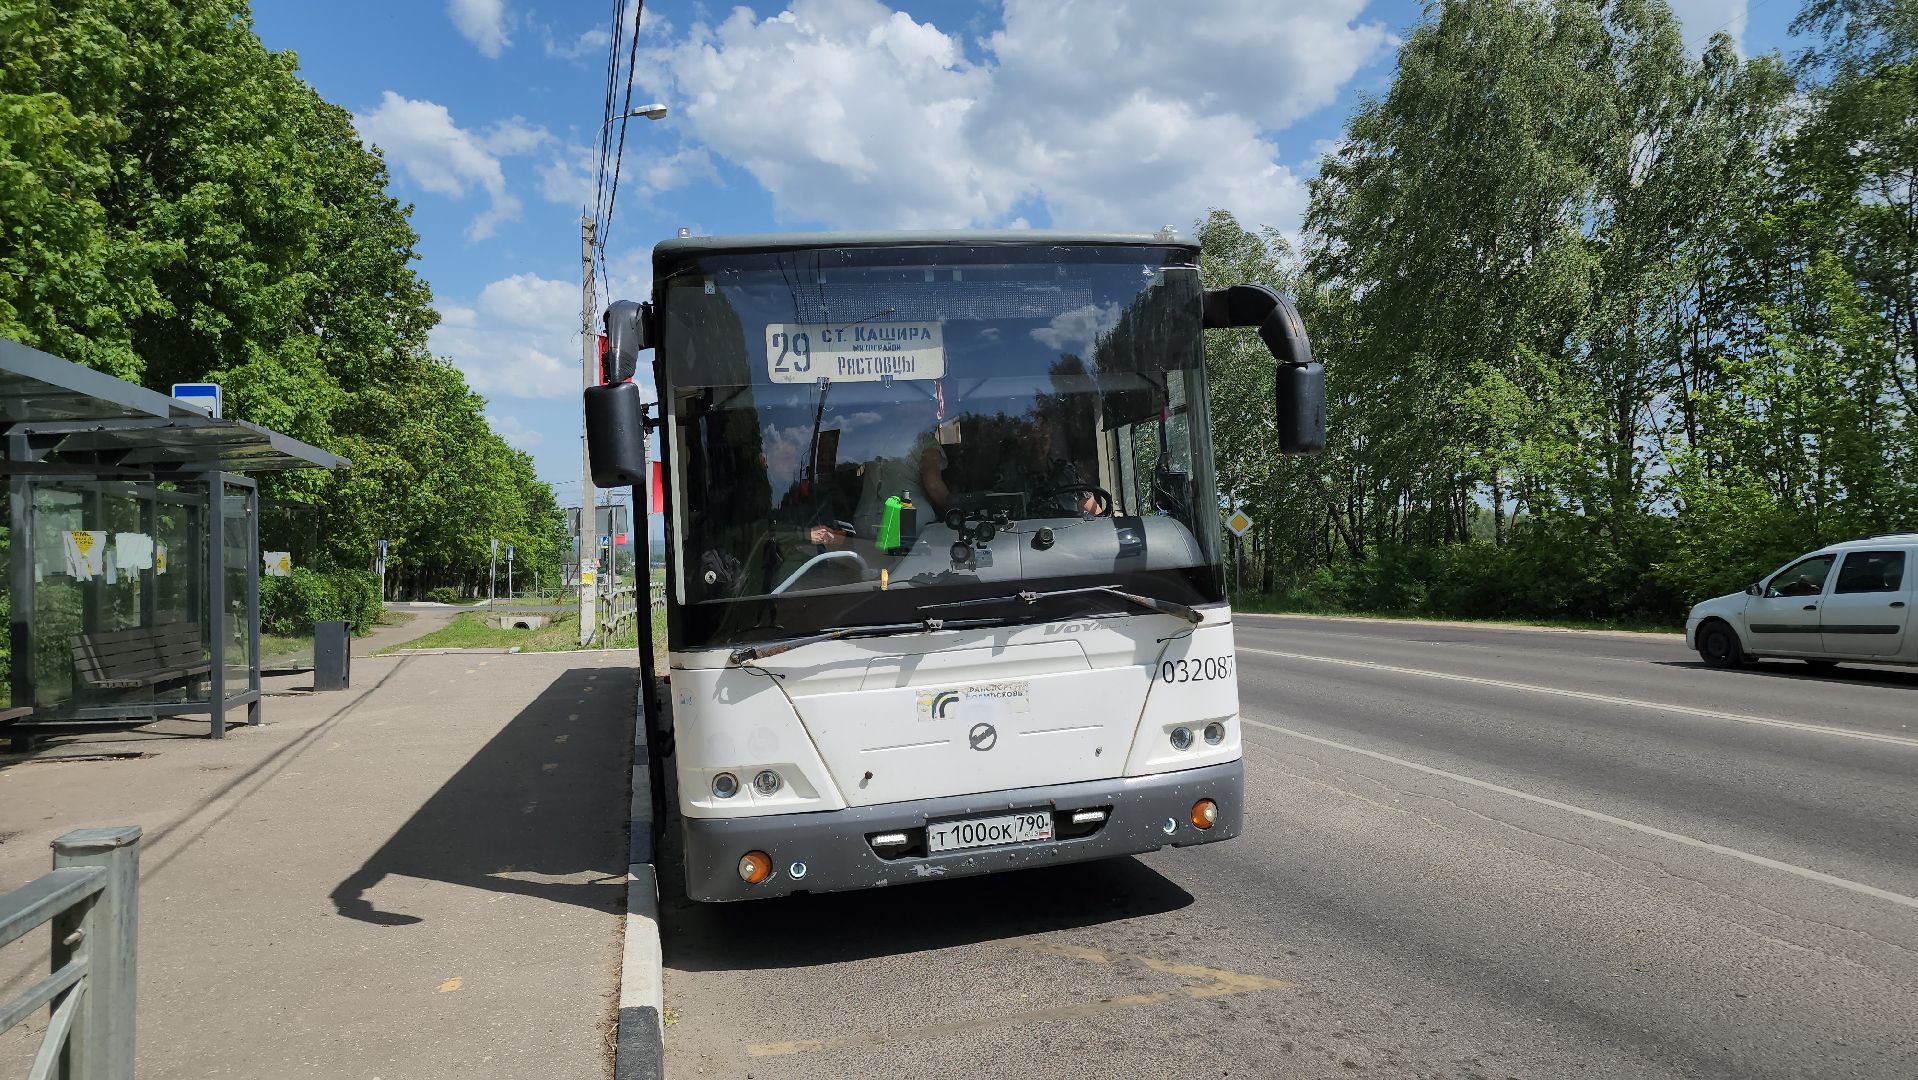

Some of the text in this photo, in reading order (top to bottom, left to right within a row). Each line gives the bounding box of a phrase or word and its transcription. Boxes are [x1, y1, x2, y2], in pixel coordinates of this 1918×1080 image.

[821, 326, 932, 343] СТ. КАШИРА
[772, 332, 811, 373] 29
[837, 355, 915, 376] РАСТОВЦЫ
[1162, 654, 1233, 684] 032087
[1016, 814, 1045, 833] 790
